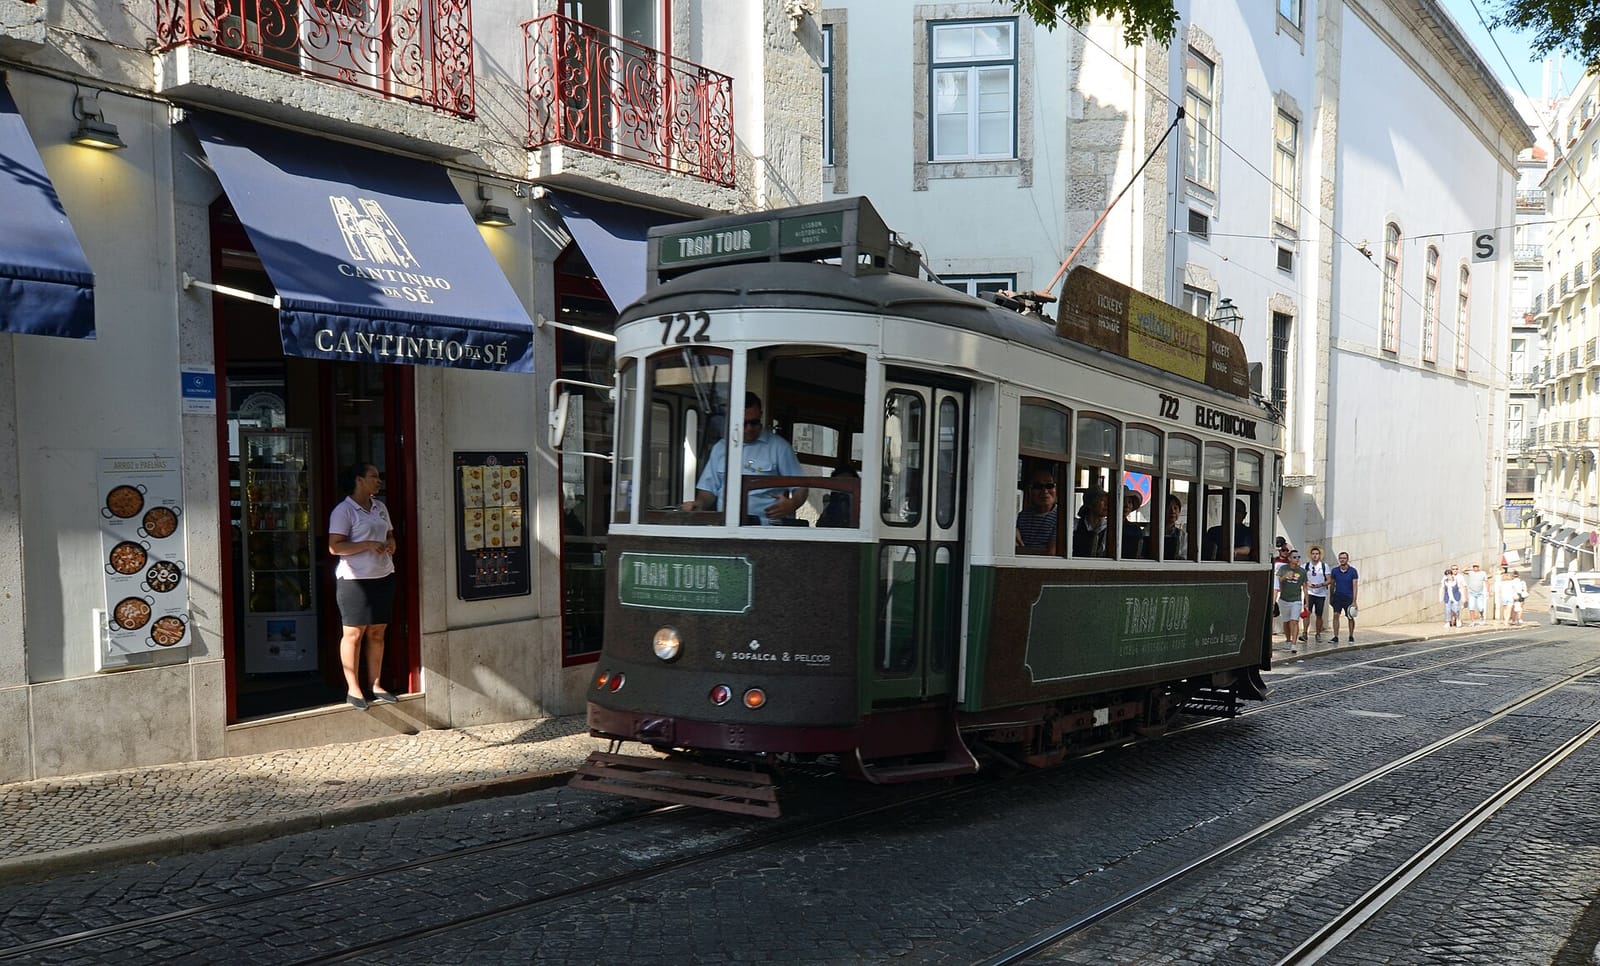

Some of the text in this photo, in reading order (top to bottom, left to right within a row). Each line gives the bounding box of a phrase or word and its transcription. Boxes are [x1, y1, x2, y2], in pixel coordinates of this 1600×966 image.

[678, 230, 751, 257] TRAM TOUR
[1475, 234, 1494, 259] S
[337, 264, 451, 290] CANTINHO
[381, 286, 434, 304] DA SÉ
[659, 311, 711, 344] 722
[315, 328, 508, 365] CANTINHO DA SÉ
[1159, 393, 1180, 420] 722
[633, 561, 719, 589] TRAM TOUR
[1160, 596, 1190, 631] TOUR
[715, 651, 831, 663] By SOFALCA & PELCOR
